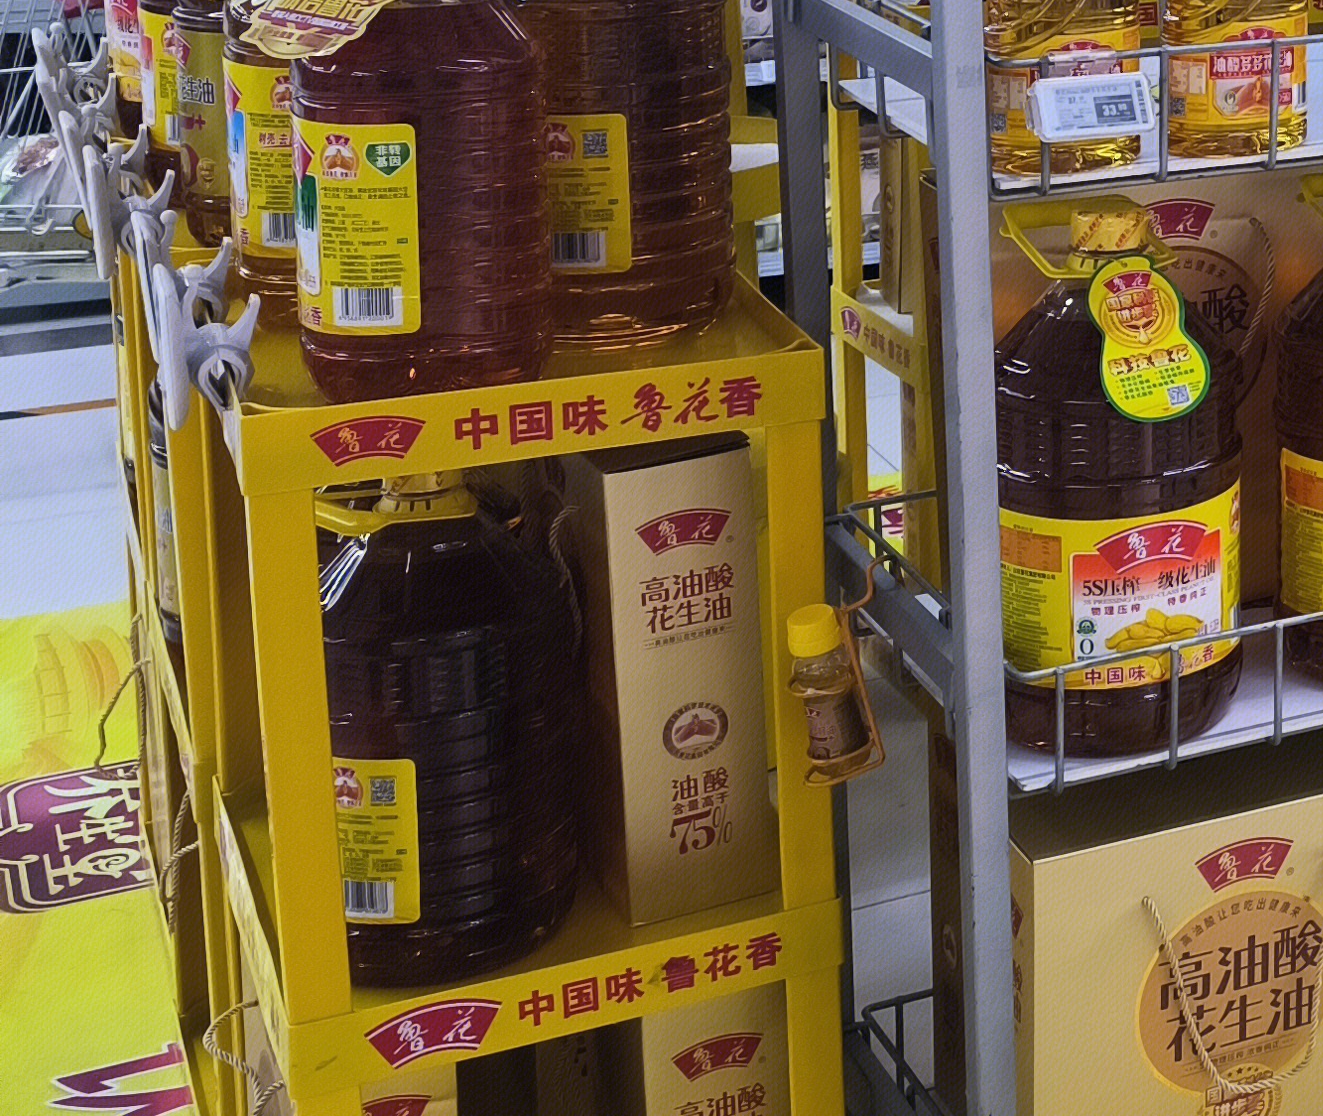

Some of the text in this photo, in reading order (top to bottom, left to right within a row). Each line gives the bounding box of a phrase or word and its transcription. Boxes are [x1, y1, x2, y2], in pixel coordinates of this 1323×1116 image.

[453, 374, 764, 451] 中国味 鲁花香
[639, 562, 735, 606] 高油酸
[643, 593, 734, 636] 花生油
[1083, 663, 1148, 687] 中国味
[670, 766, 730, 800] 油酸
[668, 812, 734, 857] 75%
[1179, 895, 1305, 948] 高油酸让您吃出健康来
[516, 931, 785, 1027] 中国味 鲁花香
[1159, 918, 1323, 1001] 高油酸
[1164, 977, 1317, 1064] 花生油
